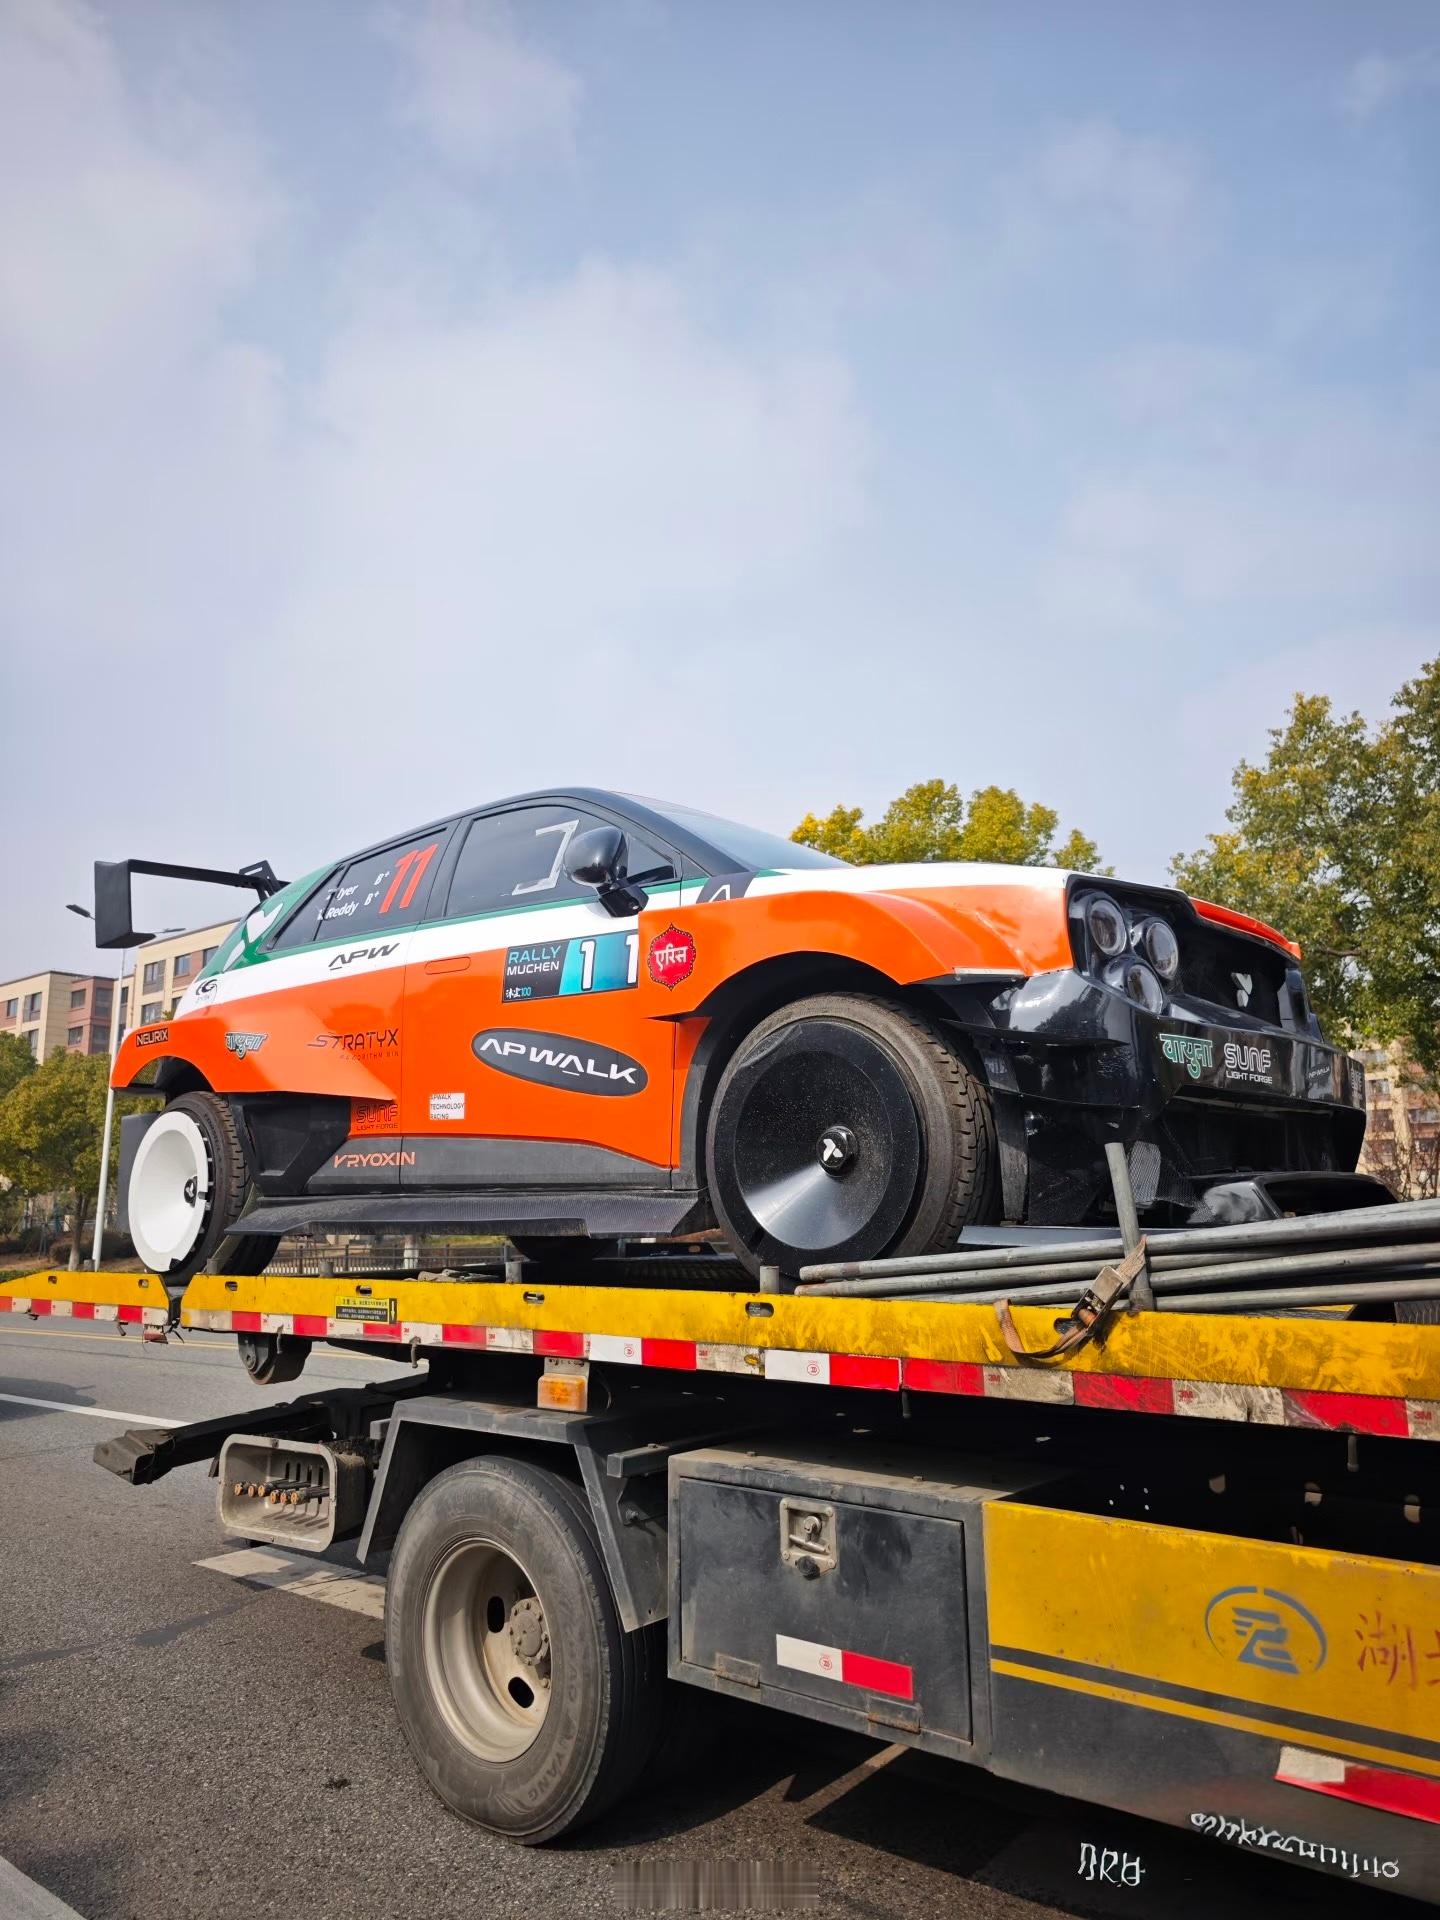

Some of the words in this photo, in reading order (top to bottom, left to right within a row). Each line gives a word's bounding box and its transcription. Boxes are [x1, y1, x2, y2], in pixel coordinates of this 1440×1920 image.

[379, 843, 439, 914] 11
[326, 901, 359, 917] Reddy
[328, 943, 400, 970] APW
[508, 946, 561, 964] RALLY
[506, 961, 560, 976] MUCHEN
[136, 1029, 168, 1046] NEURIX
[307, 1028, 399, 1050] STRATYX
[480, 1038, 637, 1084] APWALK
[1223, 1042, 1271, 1074] SUNF
[1226, 1070, 1248, 1081] LIGHT
[1249, 1073, 1272, 1085] FORGE
[430, 1102, 465, 1111] TECHNOLOGY
[988, 1374, 1001, 1382] 3M
[1178, 1390, 1194, 1400] 3M
[1414, 1410, 1432, 1421] 3M
